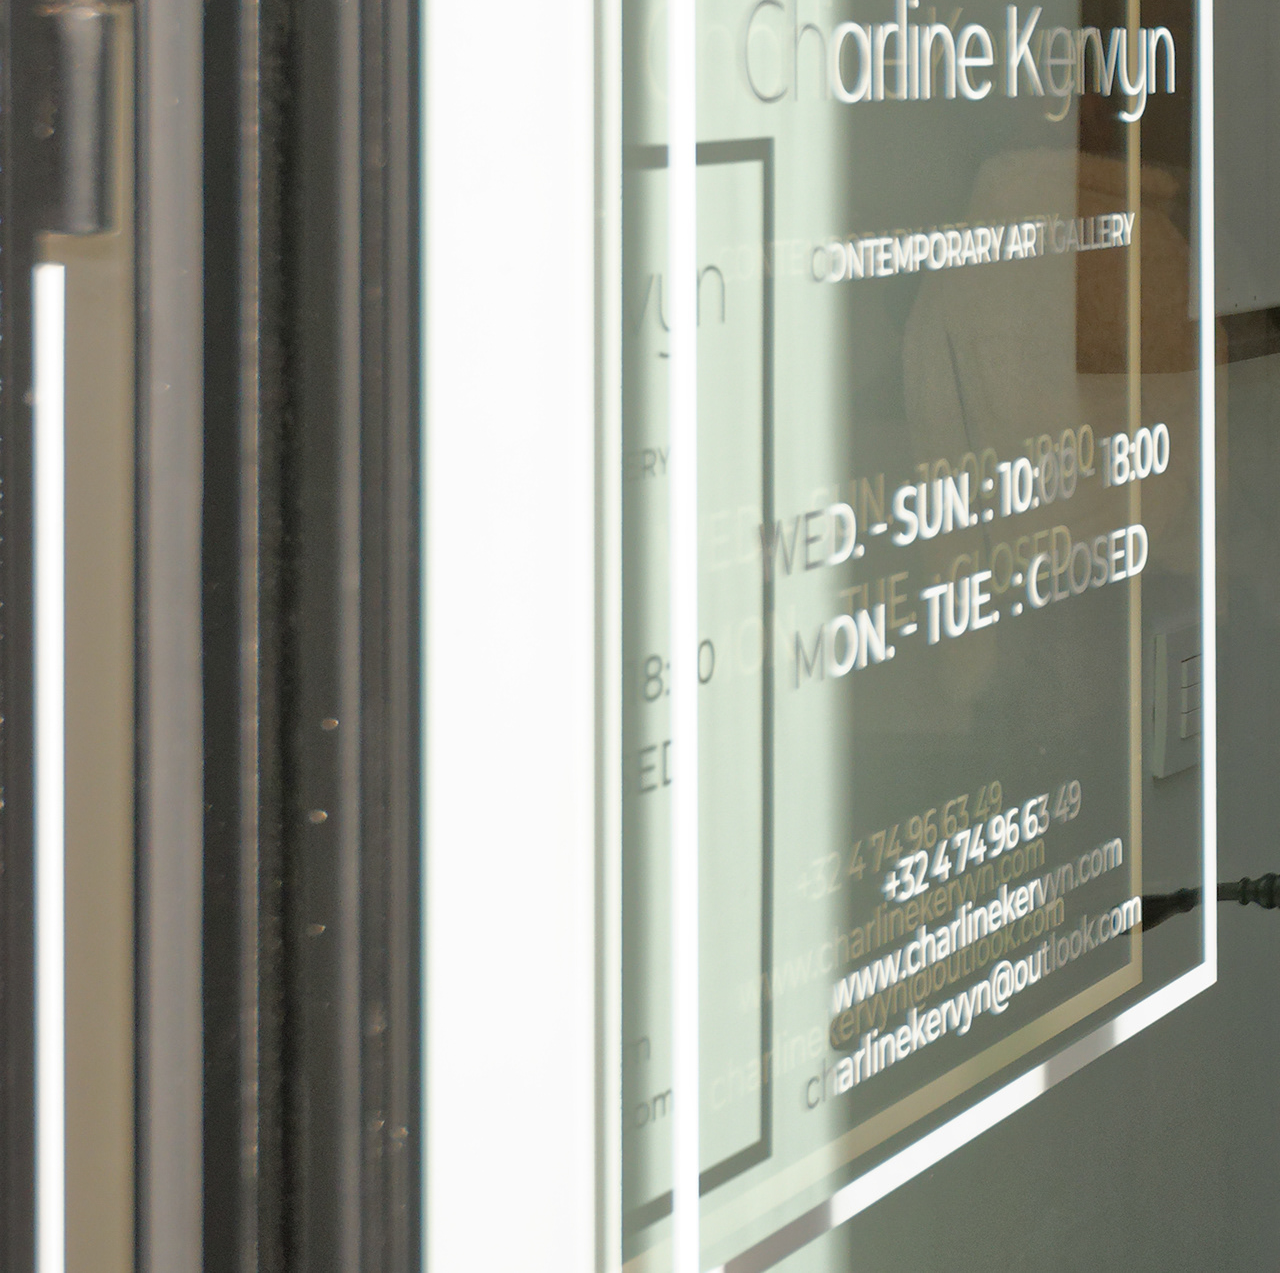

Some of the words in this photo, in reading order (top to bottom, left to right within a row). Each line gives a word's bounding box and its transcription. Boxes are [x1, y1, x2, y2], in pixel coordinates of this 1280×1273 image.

[1008, 4, 1176, 123] Kervyn
[811, 226, 1005, 284] CONTEMPORARY
[1005, 221, 1047, 262] ART
[1053, 212, 1136, 255] GALLERY
[794, 603, 896, 689] MON.
[1026, 523, 1149, 609] CLOSED
[831, 836, 1124, 1014] www.charlinekervyn.com
[880, 849, 930, 904] +32
[986, 806, 1019, 859] 96
[804, 894, 1143, 1110] charlinekervyn@outlook.com
